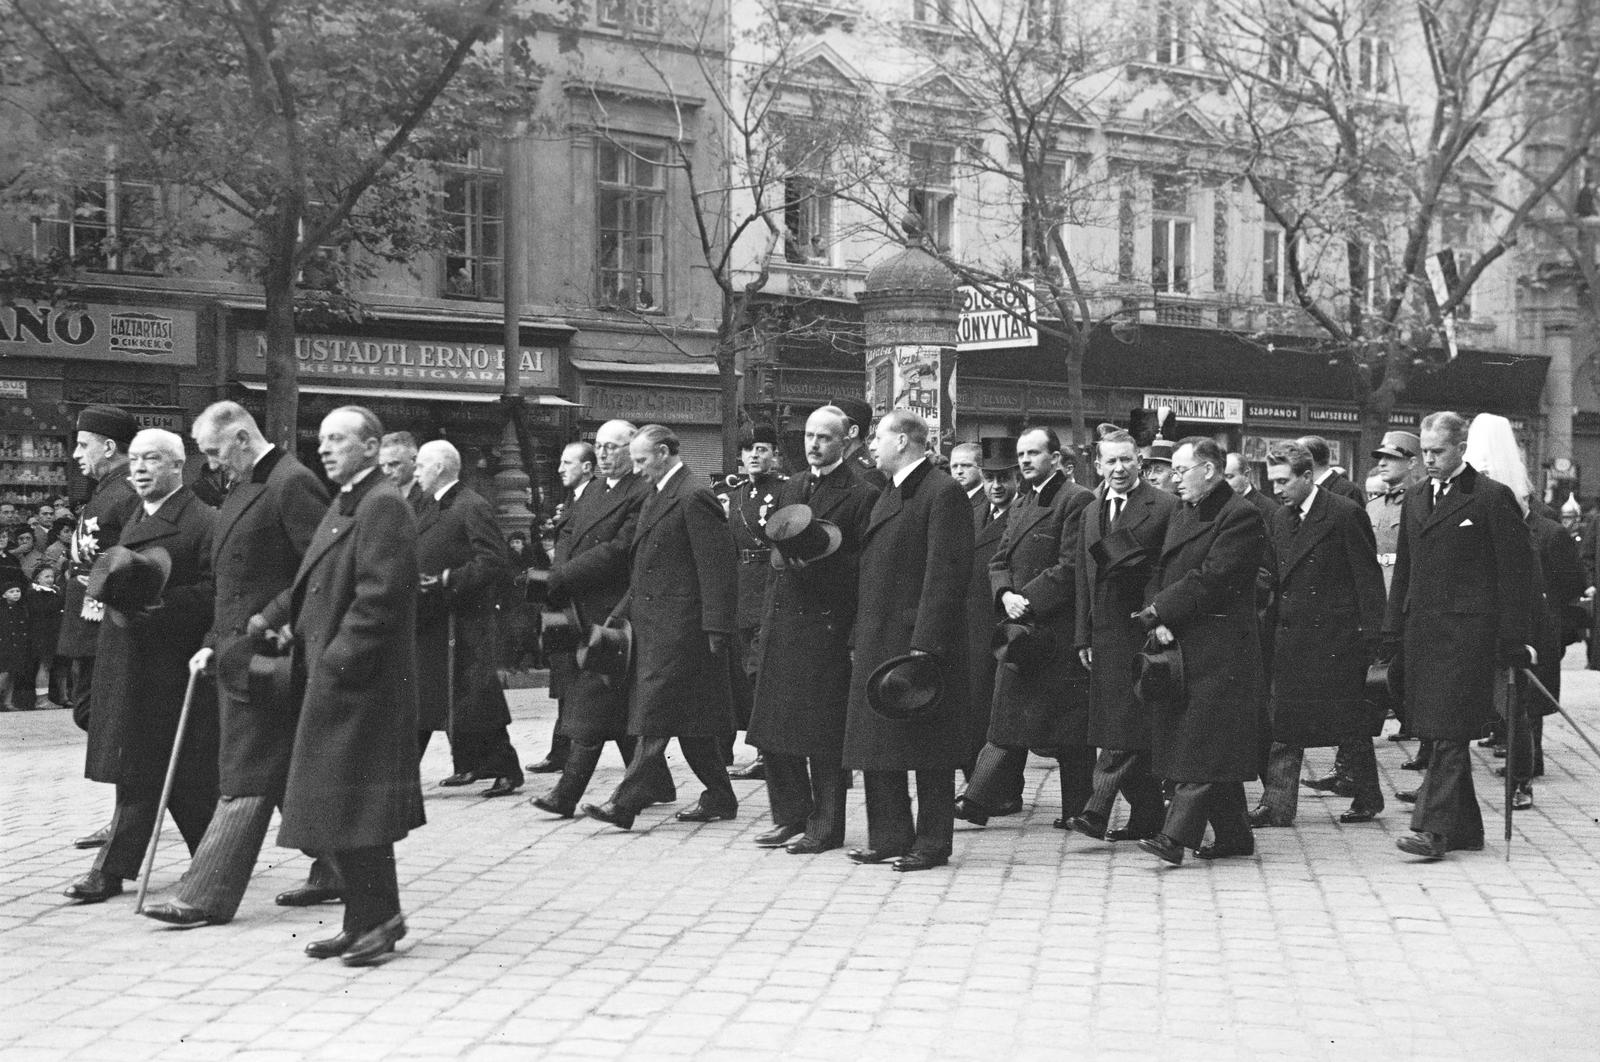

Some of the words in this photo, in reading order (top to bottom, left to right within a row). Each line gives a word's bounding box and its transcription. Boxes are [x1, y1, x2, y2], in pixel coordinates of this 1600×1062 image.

[122, 339, 161, 348] CIKKEK
[256, 335, 415, 366] NUSTADTL
[1249, 407, 1297, 418] SZAPPANOK
